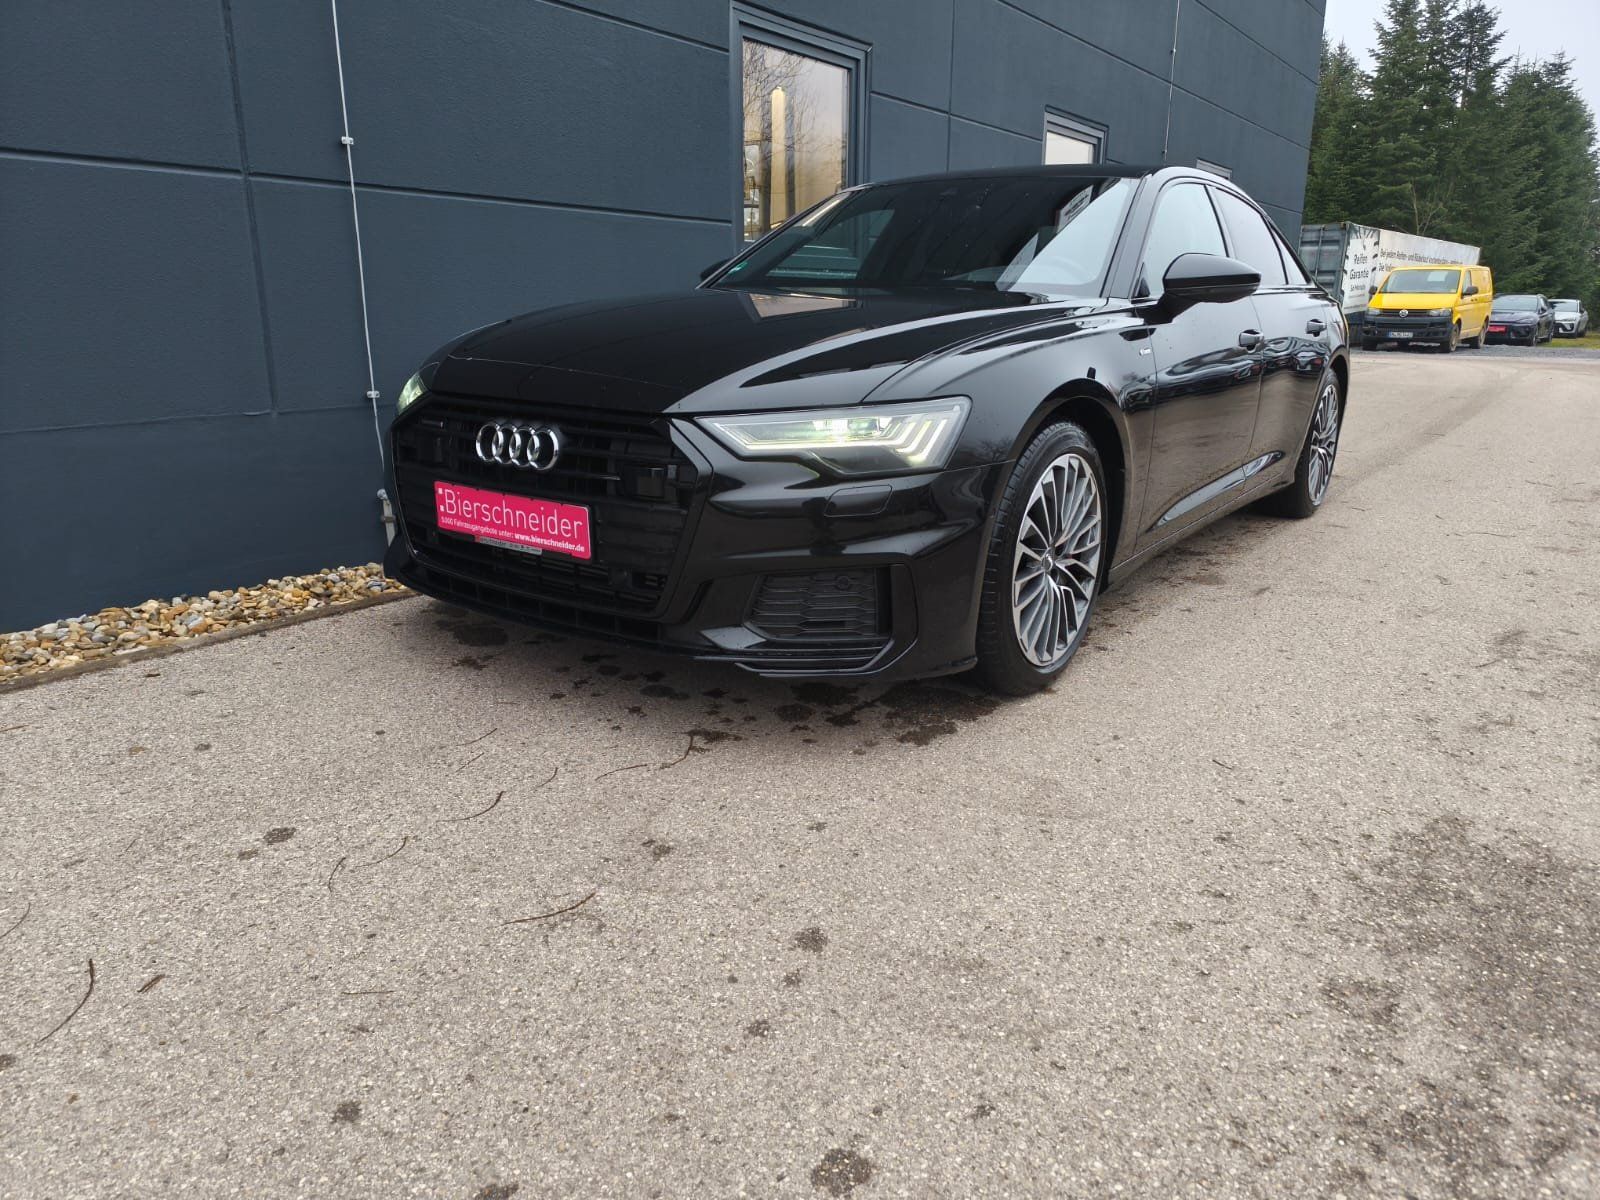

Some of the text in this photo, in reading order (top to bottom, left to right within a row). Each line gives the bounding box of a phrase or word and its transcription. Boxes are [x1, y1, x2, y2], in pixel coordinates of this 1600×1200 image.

[1354, 254, 1368, 264] Reifen
[1349, 269, 1369, 280] Garantie
[445, 489, 582, 539] Bierschneider
[453, 518, 498, 535] Fahrzeugangebote
[498, 529, 514, 539] unter:
[514, 533, 585, 553] www.bierschneider.de
